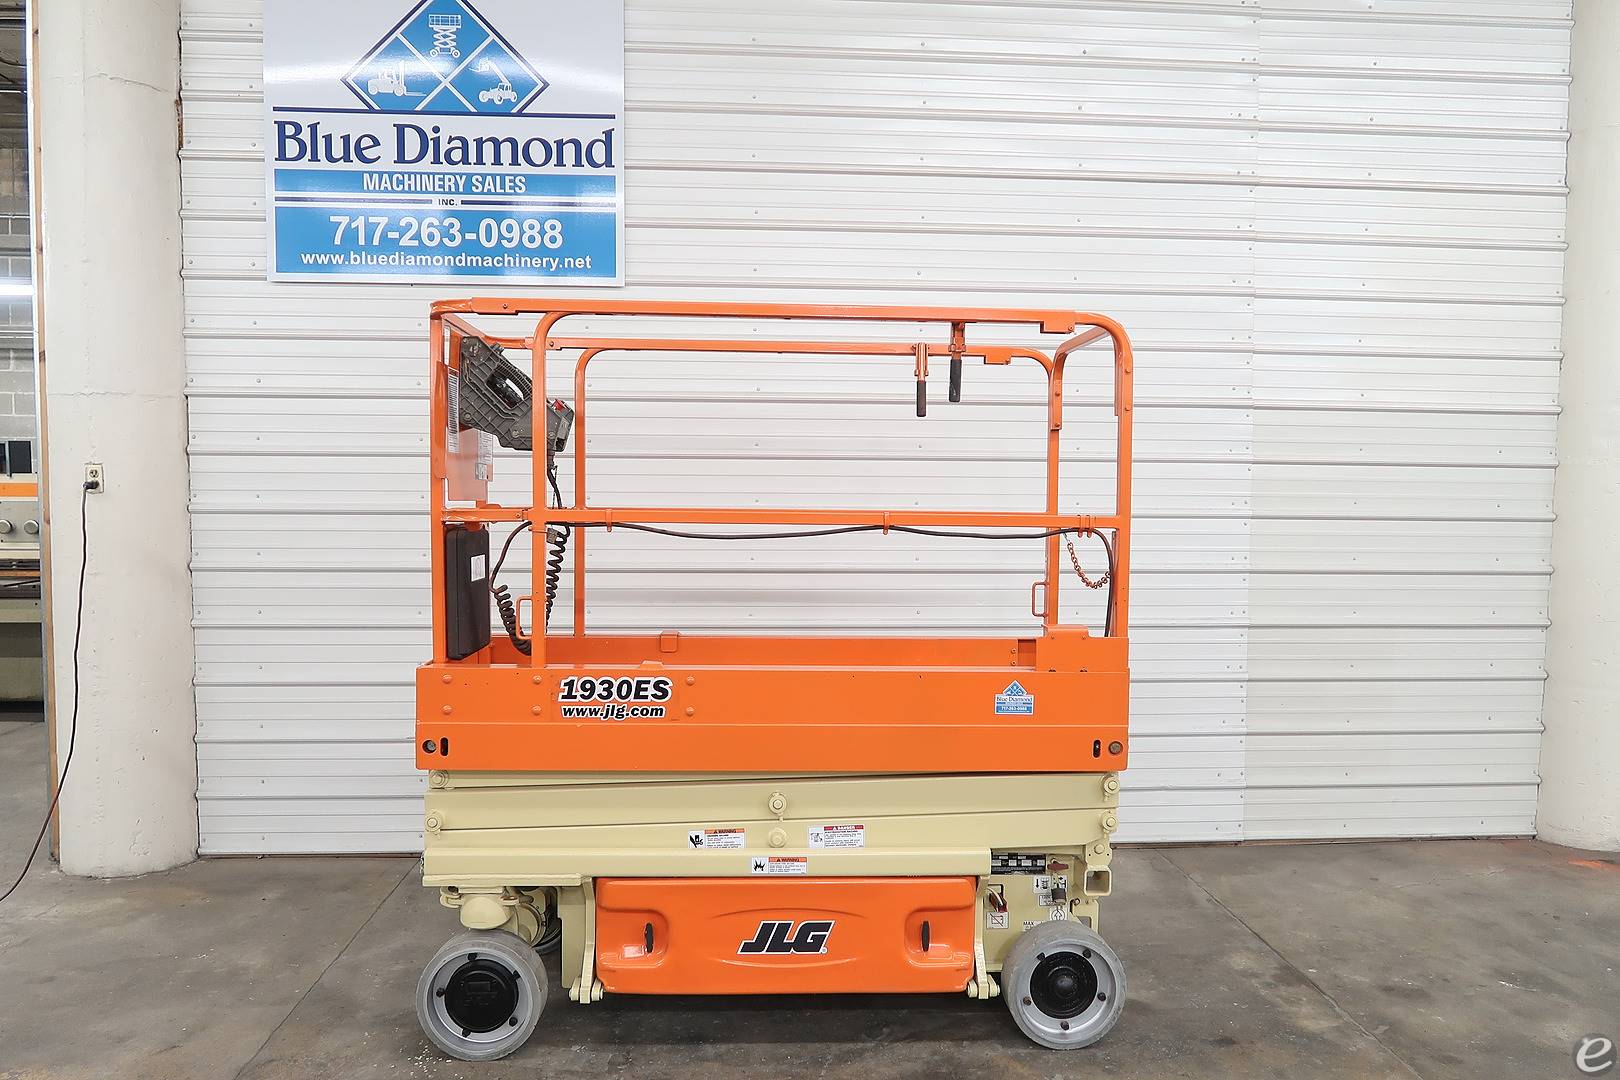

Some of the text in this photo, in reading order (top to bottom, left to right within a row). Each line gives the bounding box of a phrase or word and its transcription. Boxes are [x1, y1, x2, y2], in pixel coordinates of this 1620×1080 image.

[274, 120, 615, 169] Blue Diamond
[363, 173, 527, 194] MACHINERY SALES
[438, 198, 458, 207] INC.
[330, 215, 564, 249] 717-263-0988
[301, 251, 592, 271] www.bluediamondmachinery.net
[560, 678, 671, 701] 1930ES
[562, 704, 665, 720] www.jlg.com
[737, 921, 835, 954] JLG
